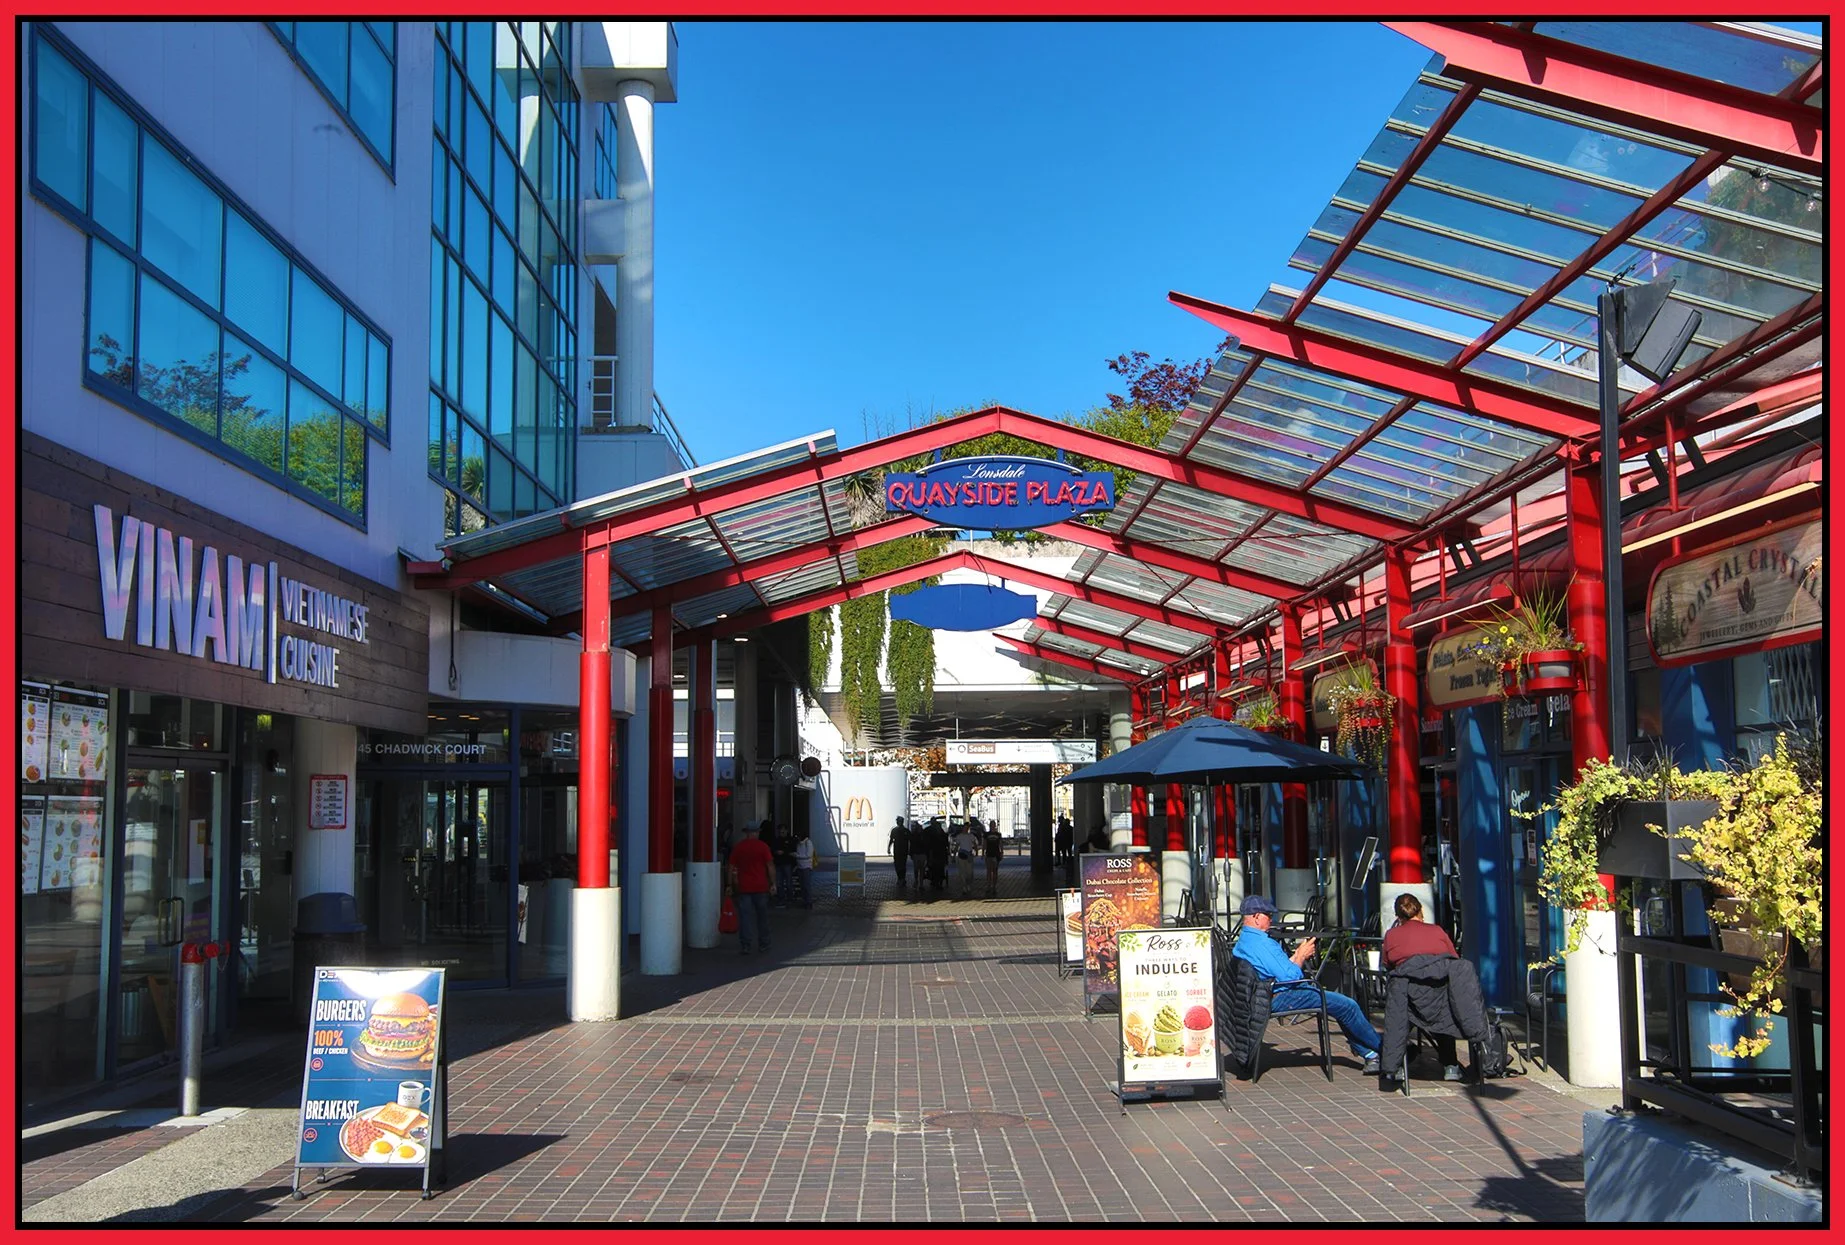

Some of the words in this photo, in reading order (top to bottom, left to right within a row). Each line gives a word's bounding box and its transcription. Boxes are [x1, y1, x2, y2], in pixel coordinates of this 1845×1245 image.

[962, 463, 1026, 479] Lonsdale
[888, 481, 1018, 510] QUAYSIDE
[1026, 481, 1109, 507] PLAZA
[93, 504, 265, 671] VINAM
[1680, 555, 1742, 637] COASTAL
[280, 576, 370, 644] VIETNAMESE
[280, 635, 340, 688] CUISINE
[375, 744, 441, 754] CHADWICK
[445, 744, 487, 755] COURT
[968, 743, 994, 753] SeaBus
[1511, 789, 1530, 812] Open
[1106, 859, 1132, 868] ROSS
[1146, 934, 1183, 952] Ross
[1135, 962, 1198, 975] INDULGE
[1156, 989, 1178, 997] GELATO
[1185, 988, 1207, 996] SORBET
[316, 1000, 367, 1021] BURGERS
[314, 1030, 344, 1047] 100%
[313, 1047, 325, 1055] BEEF
[328, 1047, 349, 1055] CHICKEN
[306, 1100, 359, 1120] BREAKFAST
